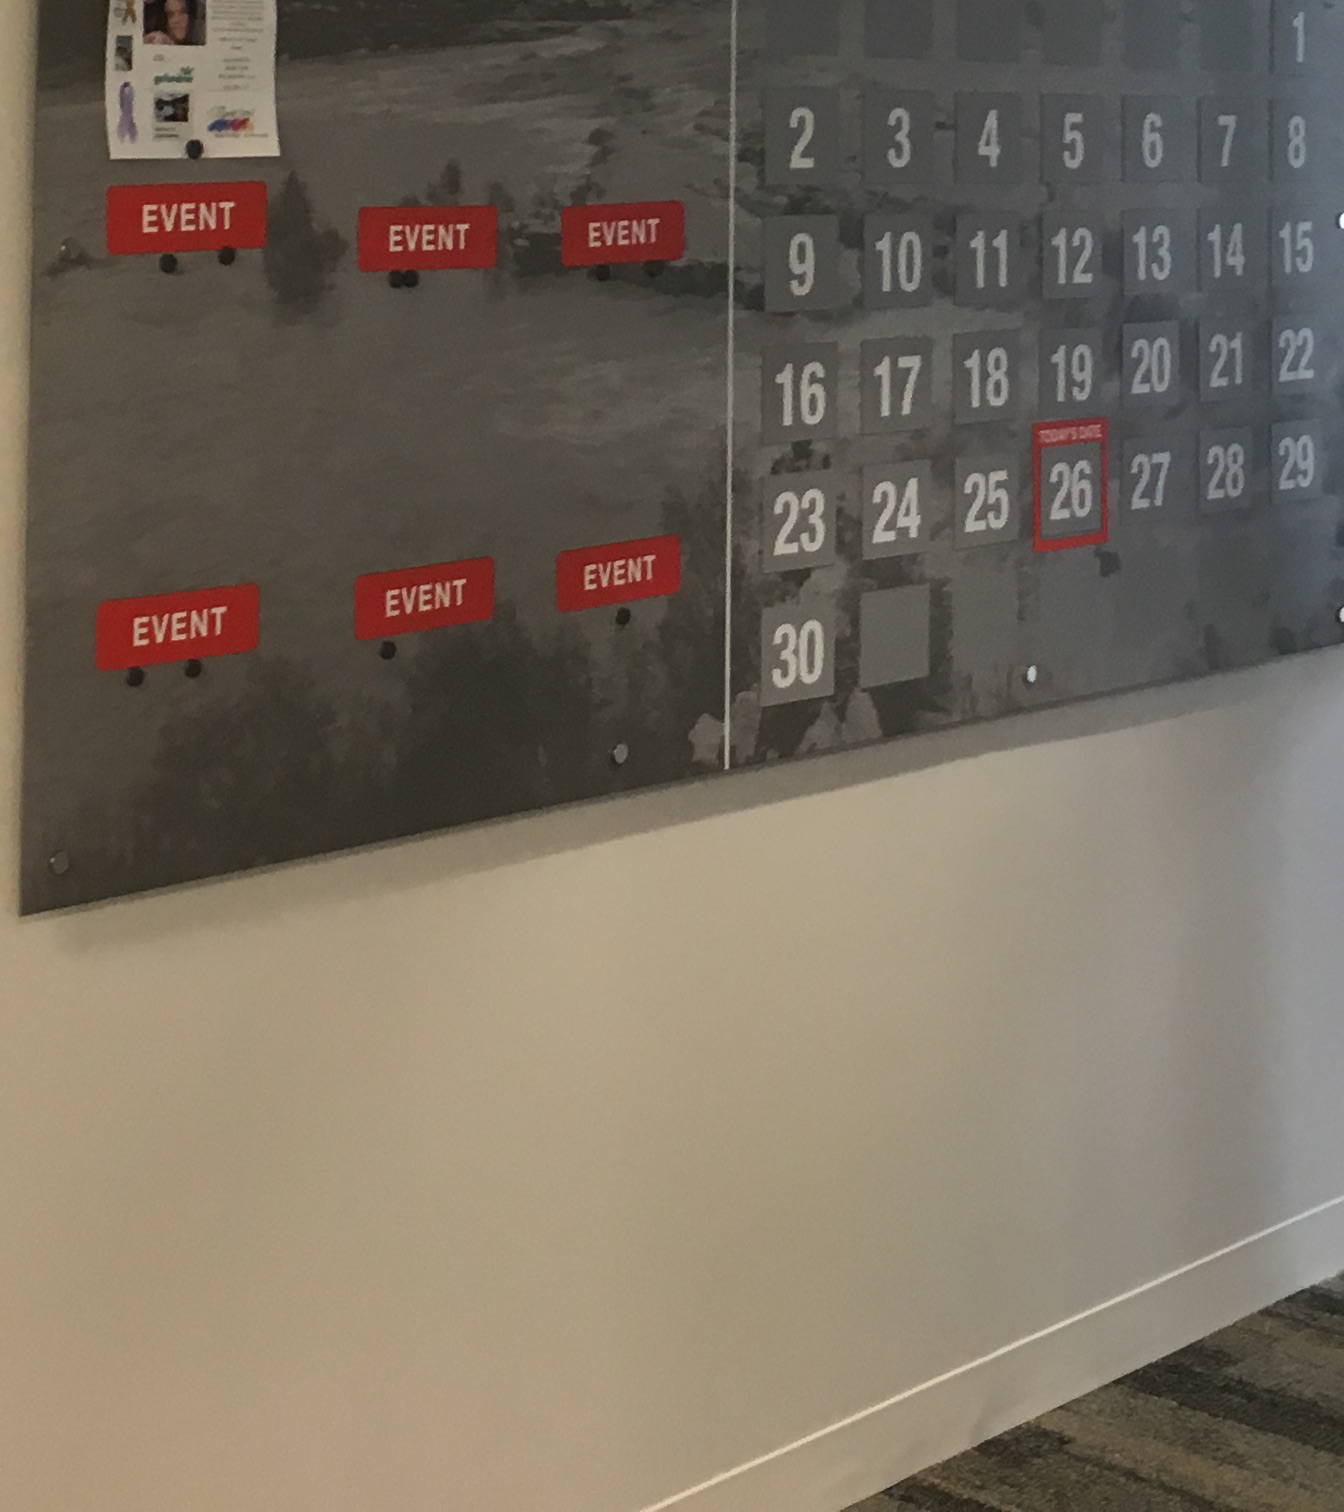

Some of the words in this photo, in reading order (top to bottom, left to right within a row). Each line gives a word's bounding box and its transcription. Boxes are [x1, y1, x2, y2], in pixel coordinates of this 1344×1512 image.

[1293, 12, 1304, 62] 1
[790, 108, 814, 168] 2
[888, 108, 910, 167] 3
[978, 110, 1000, 167] 4
[1064, 113, 1084, 168] 5
[1143, 113, 1163, 168] 6
[1218, 115, 1236, 166] 7
[1289, 116, 1306, 168] 8
[143, 202, 235, 233] EVENT
[390, 224, 469, 251] EVENT
[589, 219, 659, 247] EVENT
[789, 233, 814, 295] 9
[876, 232, 921, 292] 10
[970, 230, 1007, 288] 11
[1052, 228, 1092, 284] 12
[1133, 226, 1171, 280] 13
[1208, 223, 1245, 278] 14
[1280, 221, 1314, 272] 15
[776, 362, 825, 426] 16
[875, 356, 921, 416] 17
[964, 348, 1008, 407] 18
[1052, 345, 1092, 401] 19
[1132, 338, 1171, 393] 20
[1209, 333, 1242, 387] 21
[1280, 328, 1314, 381] 22
[774, 489, 825, 555] 23
[873, 478, 920, 543] 24
[965, 471, 1008, 532] 25
[1050, 461, 1092, 520] 26
[1131, 452, 1171, 509] 27
[1207, 444, 1244, 499] 28
[1280, 435, 1315, 489] 29
[585, 555, 655, 590] EVENT
[386, 579, 466, 617] EVENT
[134, 607, 226, 646] EVENT
[773, 620, 824, 688] 30
